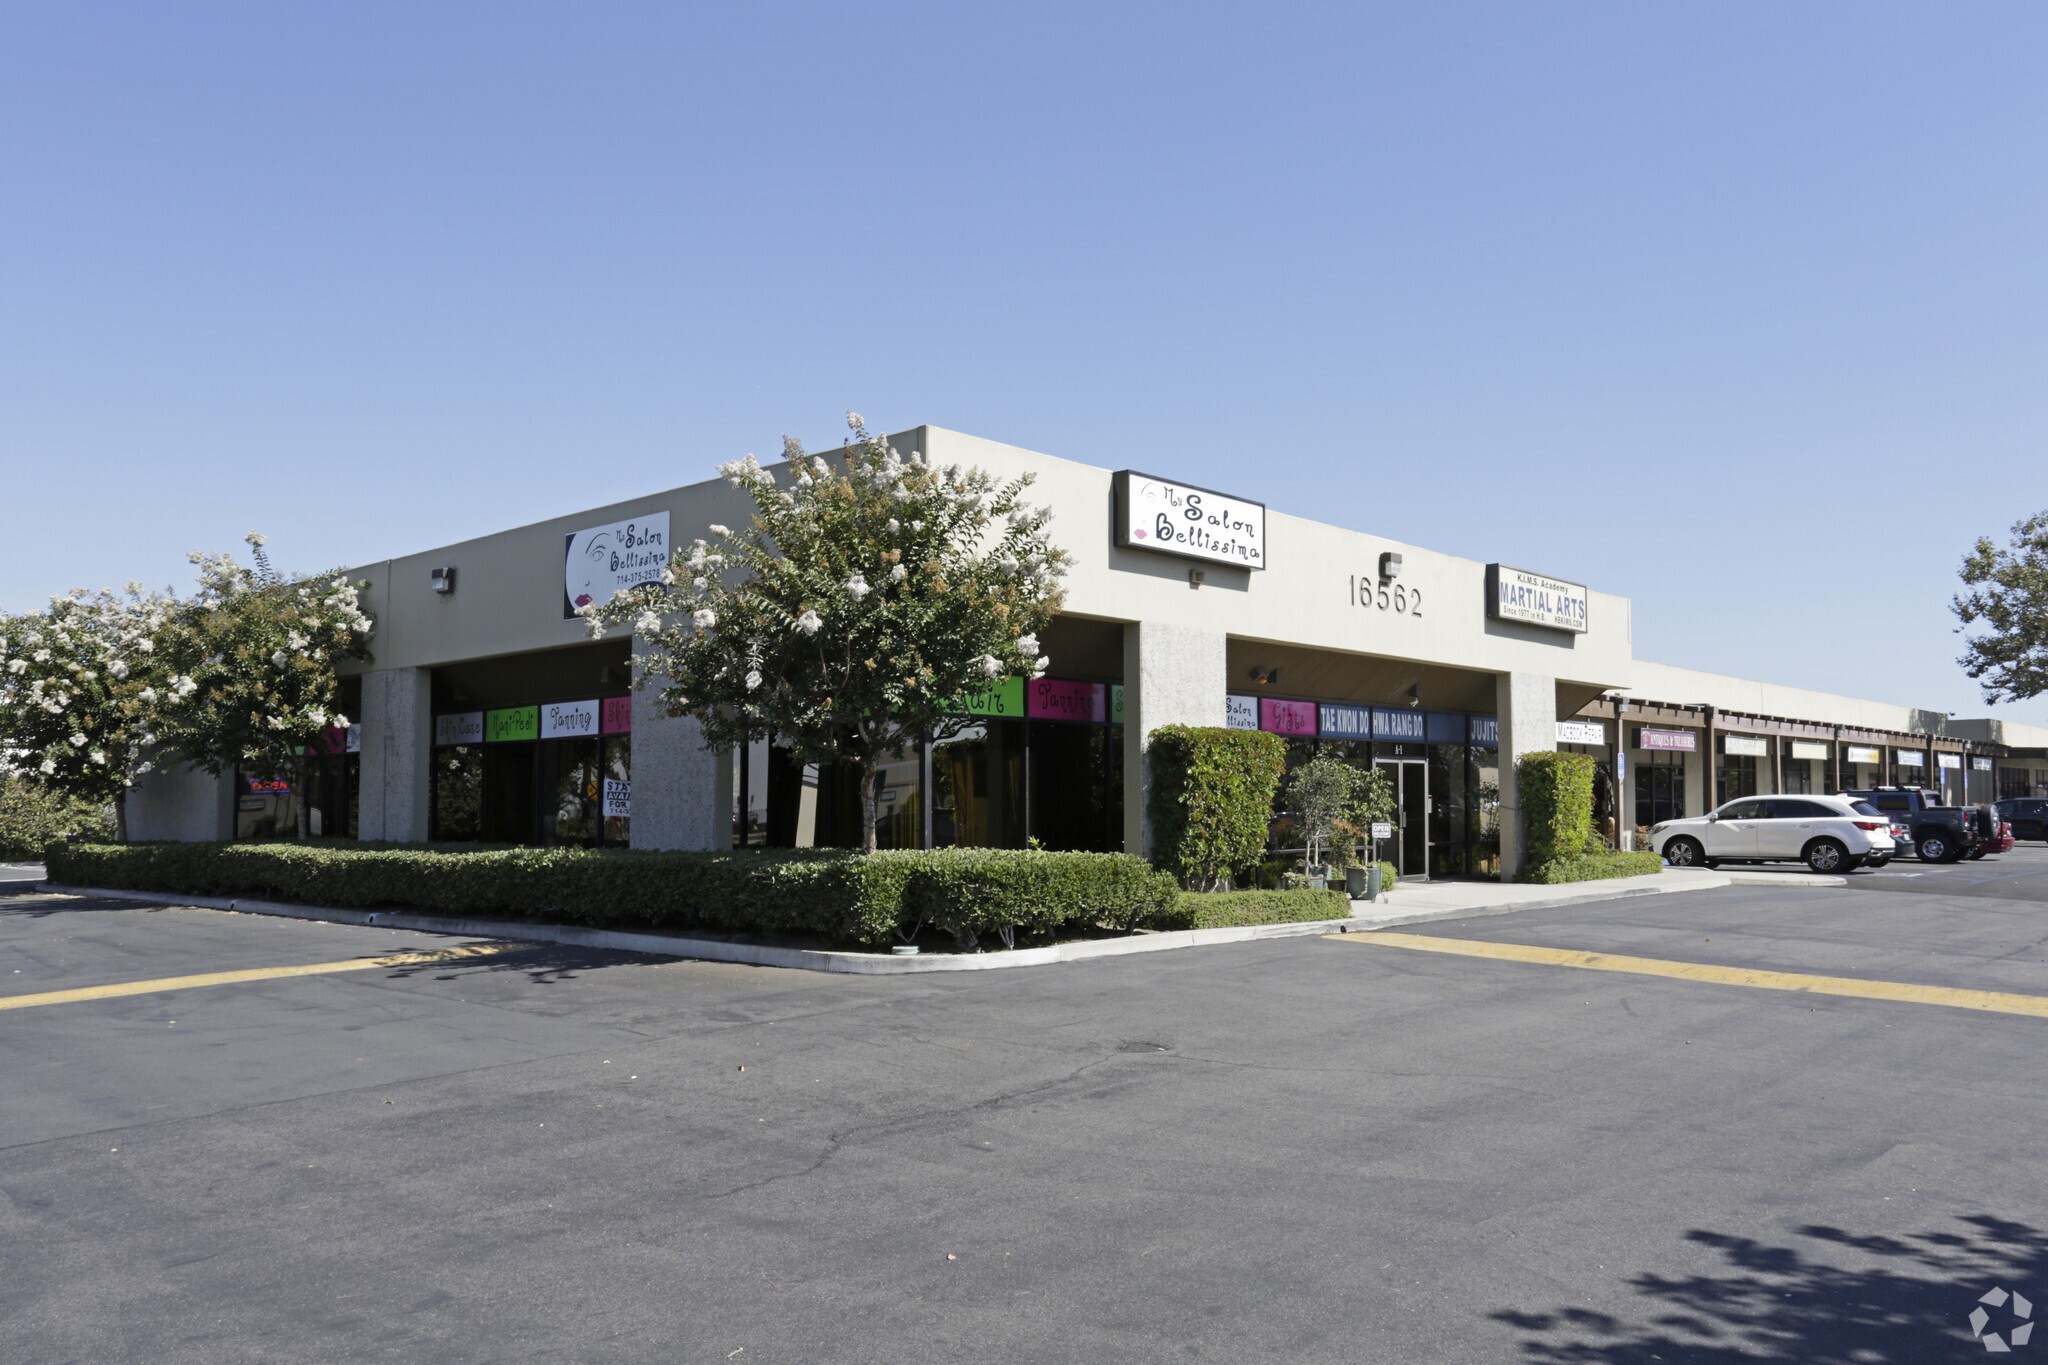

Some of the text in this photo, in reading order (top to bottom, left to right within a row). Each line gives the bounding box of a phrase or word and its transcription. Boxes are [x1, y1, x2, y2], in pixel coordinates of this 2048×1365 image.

[1184, 494, 1254, 537] Salon
[625, 524, 662, 549] Salon
[1156, 512, 1260, 560] Bellissima
[610, 551, 666, 572] Bellissima
[616, 569, 660, 585] 714-375-2578
[1541, 580, 1568, 595] Academy
[1349, 574, 1422, 618] 16562
[1500, 582, 1585, 620] MARTIAL ARTS
[1503, 605, 1516, 616] Since
[1518, 609, 1529, 618] 1977
[1039, 683, 1095, 715] Tanning
[1226, 697, 1252, 716] Salon
[493, 710, 533, 738] Mani-Pedi
[550, 706, 592, 731] Tanning
[1273, 702, 1305, 731] Gifts
[1320, 707, 1369, 734] TAE KWON DO
[1372, 711, 1423, 736] HWA RANG DO
